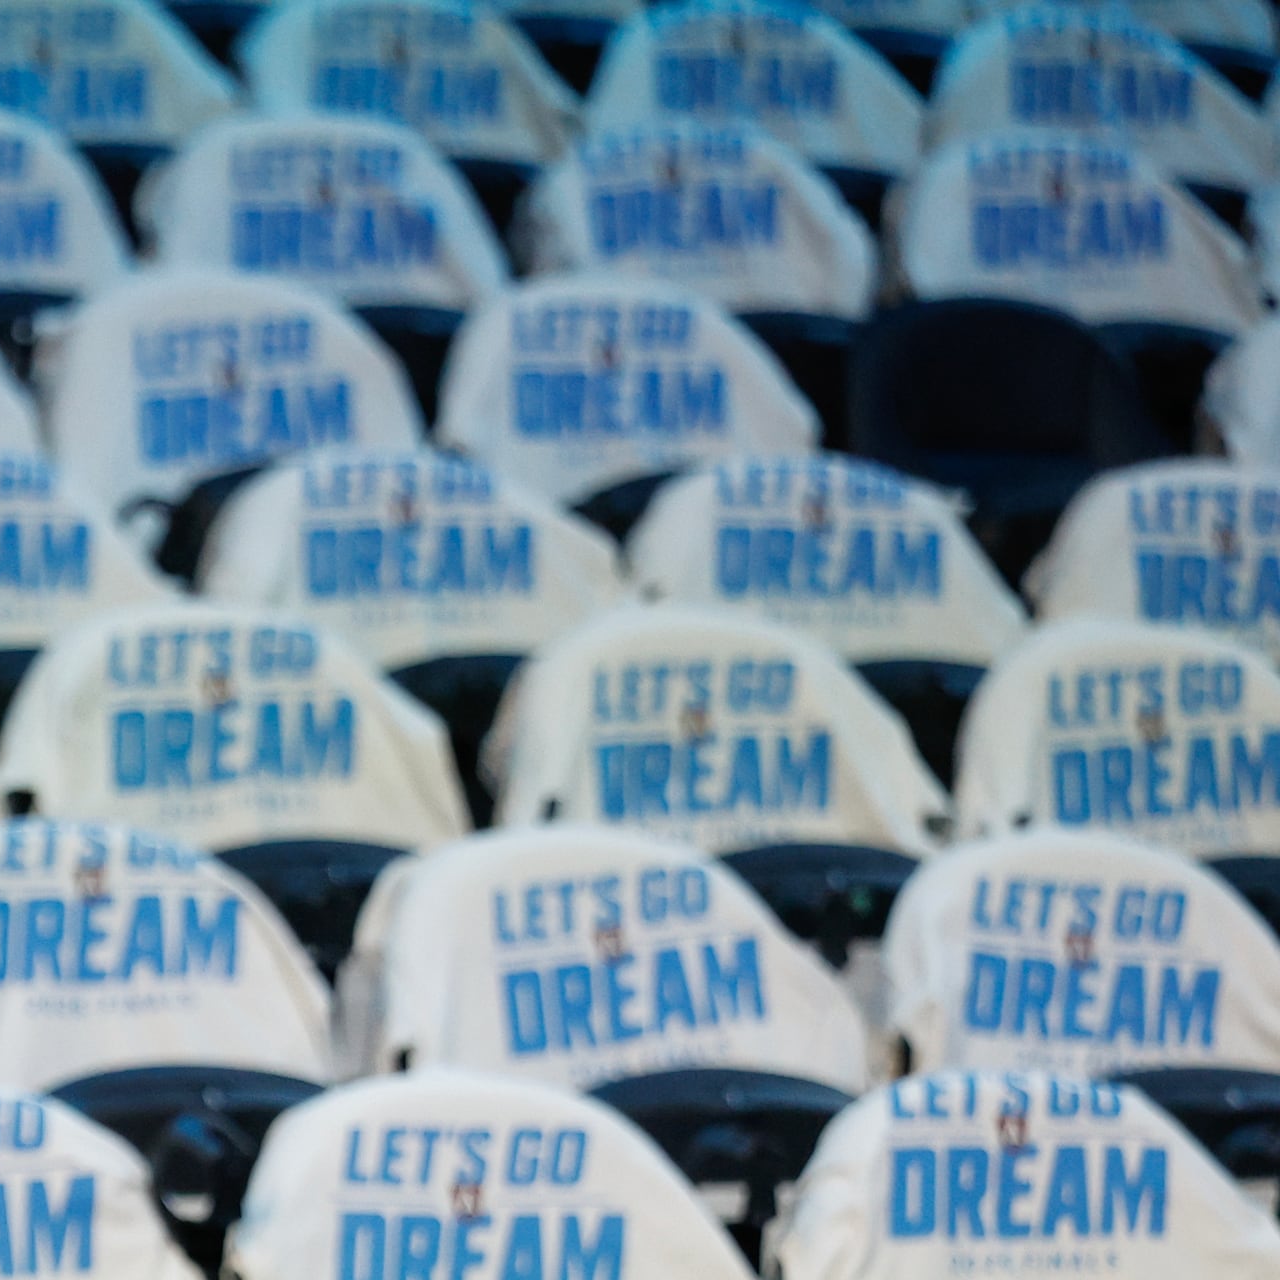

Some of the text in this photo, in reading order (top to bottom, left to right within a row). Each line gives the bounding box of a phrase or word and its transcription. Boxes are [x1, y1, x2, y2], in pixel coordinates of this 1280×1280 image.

[498, 869, 708, 943] LET'S GO
[975, 882, 1186, 939] LET'S GO
[504, 938, 765, 1055] DREAM
[964, 951, 1220, 1047] DREAM
[346, 1129, 586, 1184] LET'S GO
[890, 1146, 1167, 1238] DREAM
